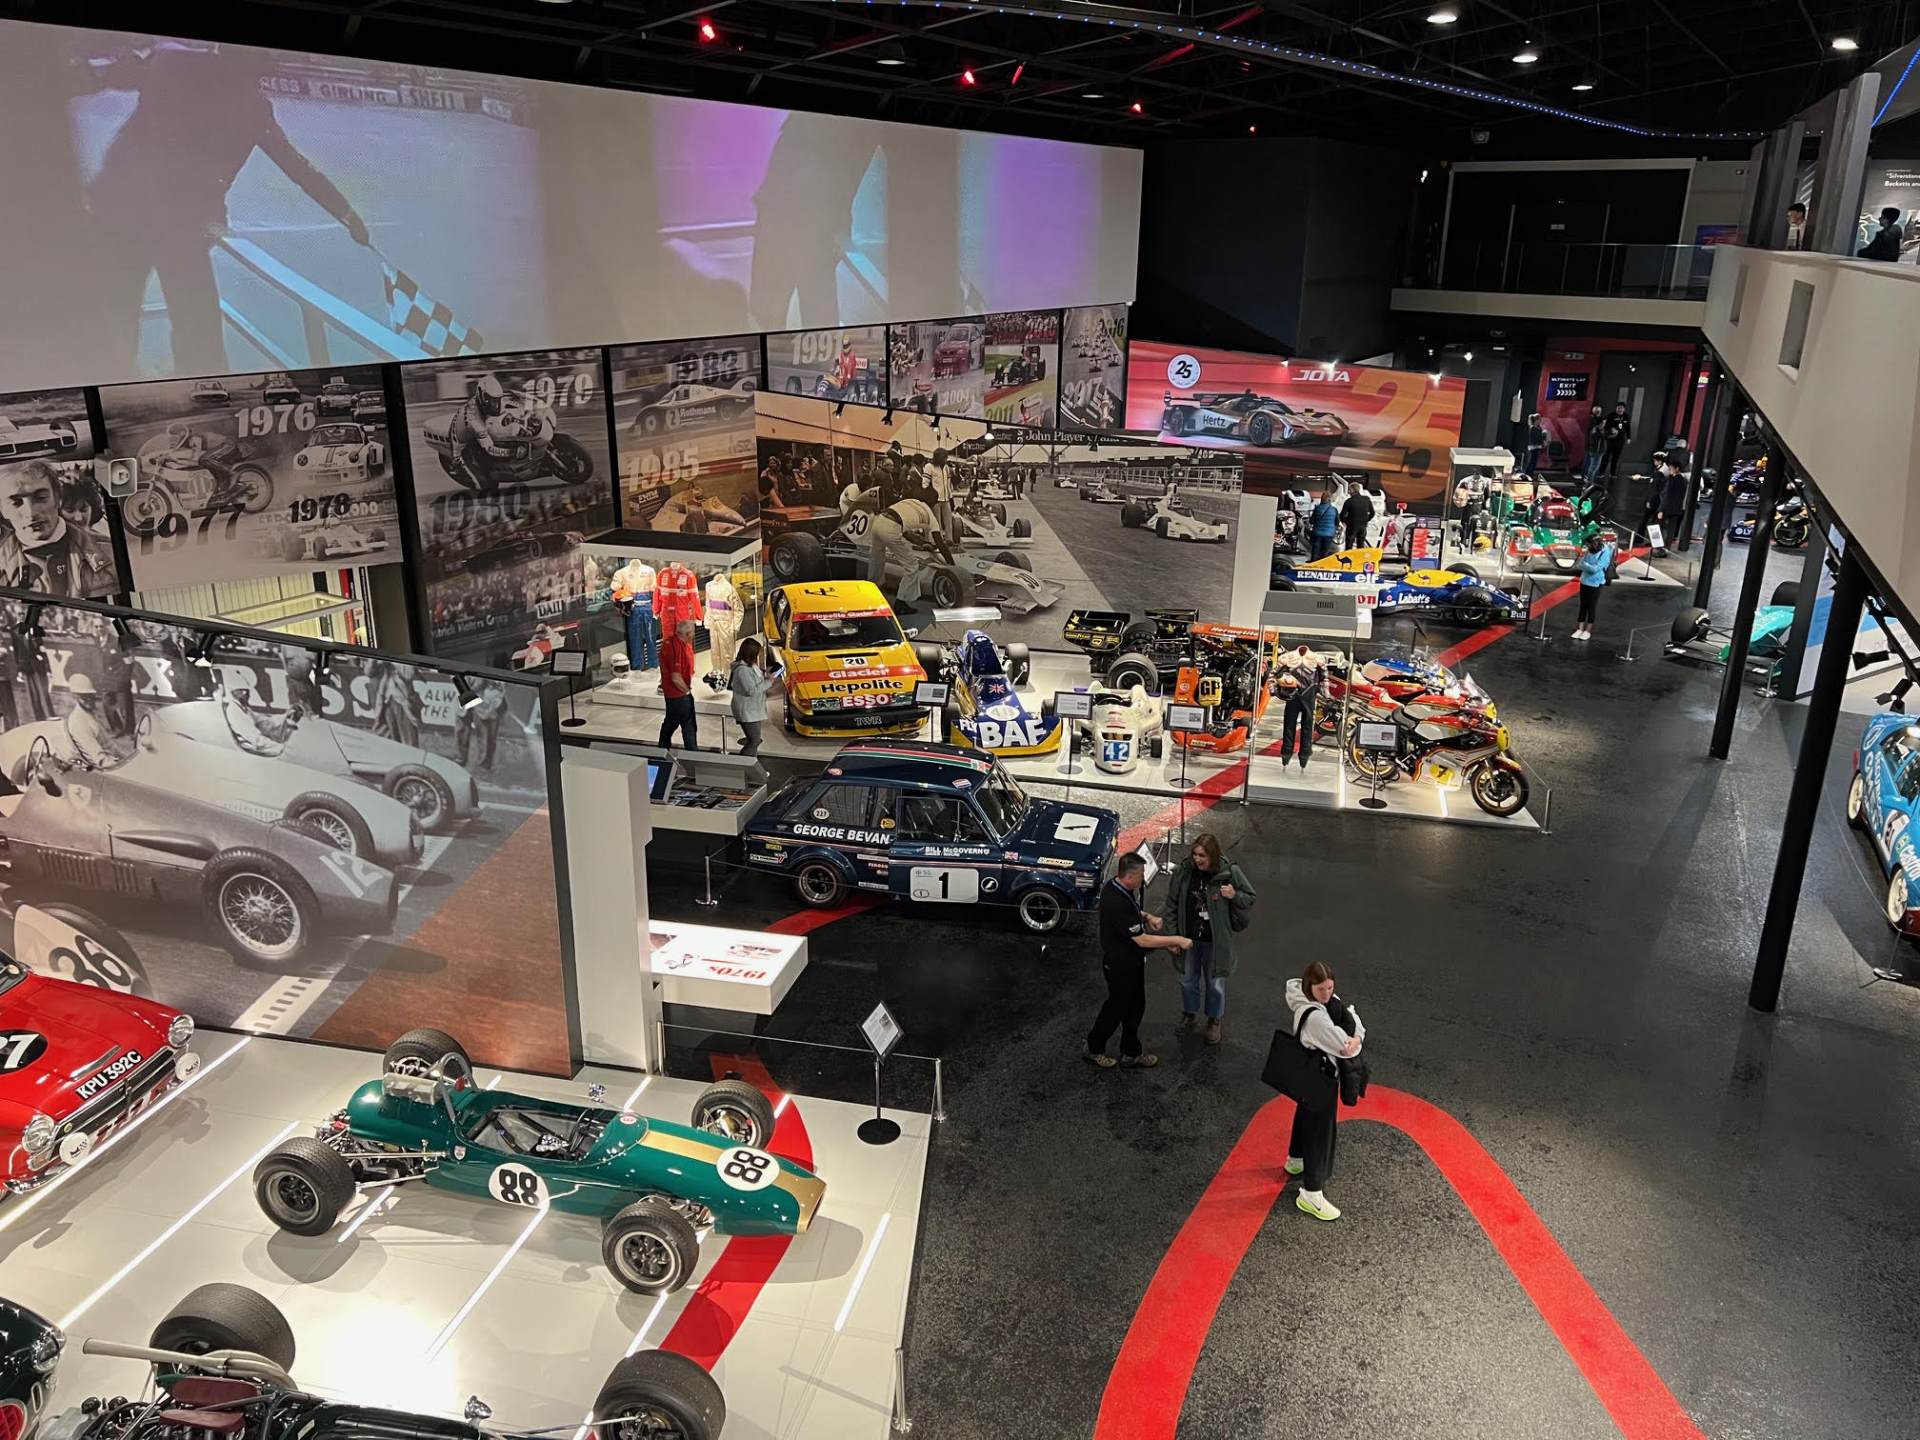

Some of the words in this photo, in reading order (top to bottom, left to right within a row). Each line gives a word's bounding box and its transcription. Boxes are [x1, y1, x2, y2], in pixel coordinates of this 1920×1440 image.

[1175, 360, 1193, 379] 25
[1291, 369, 1350, 383] JOTA
[522, 373, 593, 411] 1979
[235, 402, 317, 438] 1976
[1203, 414, 1226, 428] Hertz
[1025, 430, 1051, 442] John
[1053, 431, 1087, 443] Player
[625, 447, 700, 493] 1985
[289, 493, 351, 524] 1978
[140, 502, 247, 557] 1977
[847, 515, 869, 535] 30
[1297, 570, 1342, 581] RENAULT
[844, 657, 866, 667] 20
[828, 667, 890, 679] Glacier
[821, 679, 904, 694] Hepolite
[842, 693, 889, 708] ESSO
[1104, 741, 1131, 762] 42
[1436, 764, 1449, 779] 7
[793, 823, 846, 840] GEORGE
[846, 829, 890, 845] BEVAN
[938, 871, 950, 899] 1
[707, 964, 768, 980] 1970s
[75, 1073, 109, 1100] KPU
[105, 1050, 142, 1081] 392C
[725, 1149, 770, 1185] 88
[498, 1167, 540, 1206] 88
